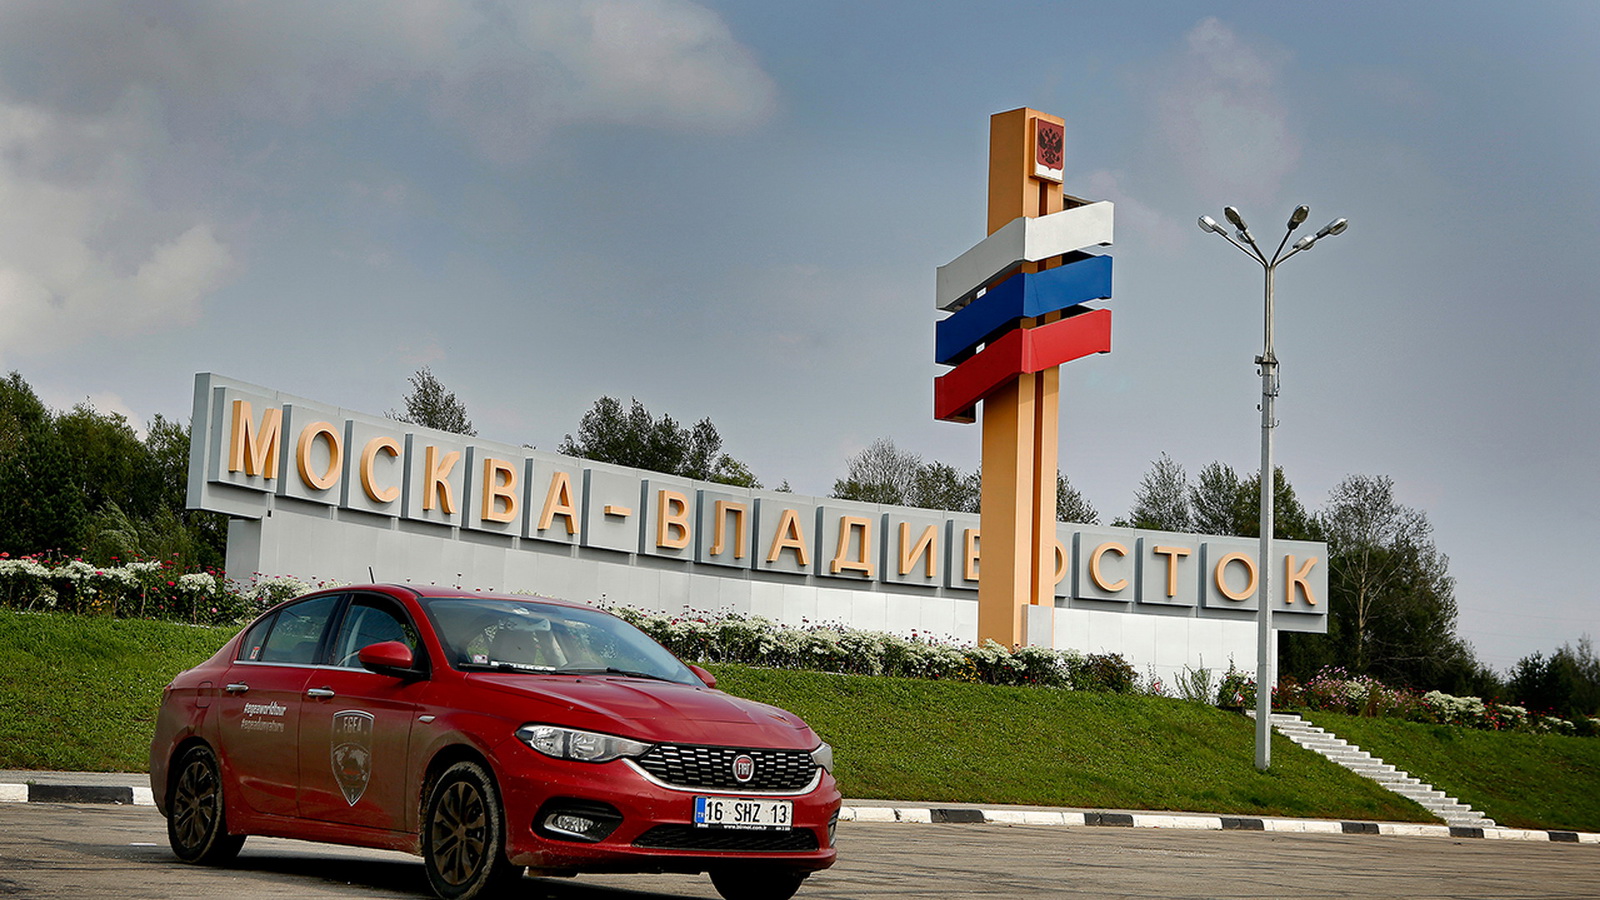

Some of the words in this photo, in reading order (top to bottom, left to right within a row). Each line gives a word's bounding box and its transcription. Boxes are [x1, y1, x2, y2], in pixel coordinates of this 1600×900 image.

[707, 801, 723, 821] 16
[734, 802, 761, 823] SHZ
[771, 804, 787, 824] 13
